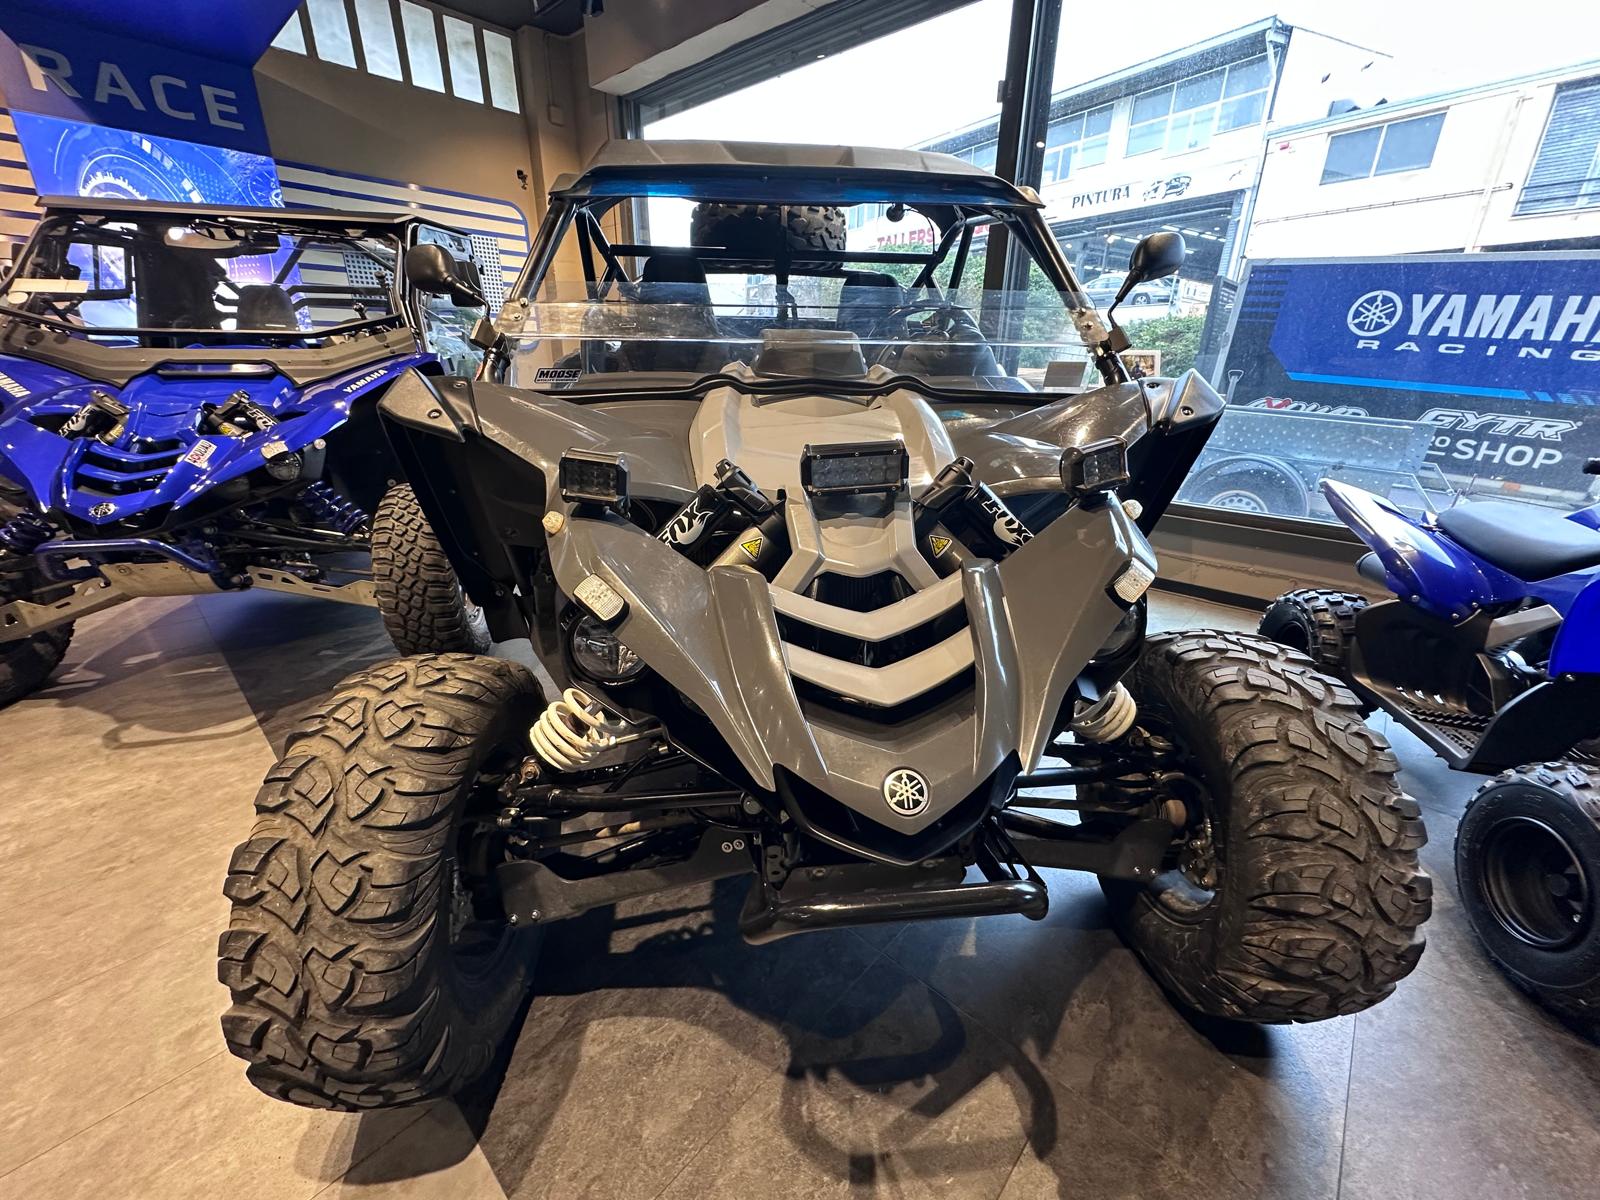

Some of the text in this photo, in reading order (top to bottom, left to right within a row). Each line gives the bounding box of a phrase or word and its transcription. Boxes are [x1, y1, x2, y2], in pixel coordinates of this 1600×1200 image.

[19, 43, 245, 131] RACE
[1072, 185, 1130, 208] PINTURA
[1408, 294, 1600, 342] YAMAH
[1356, 339, 1600, 361] RACING
[342, 369, 388, 393] YAMAHA
[539, 370, 581, 379] MOOSE
[1452, 438, 1563, 469] SHOP
[656, 497, 714, 547] FOX
[981, 499, 1034, 547] FOX
